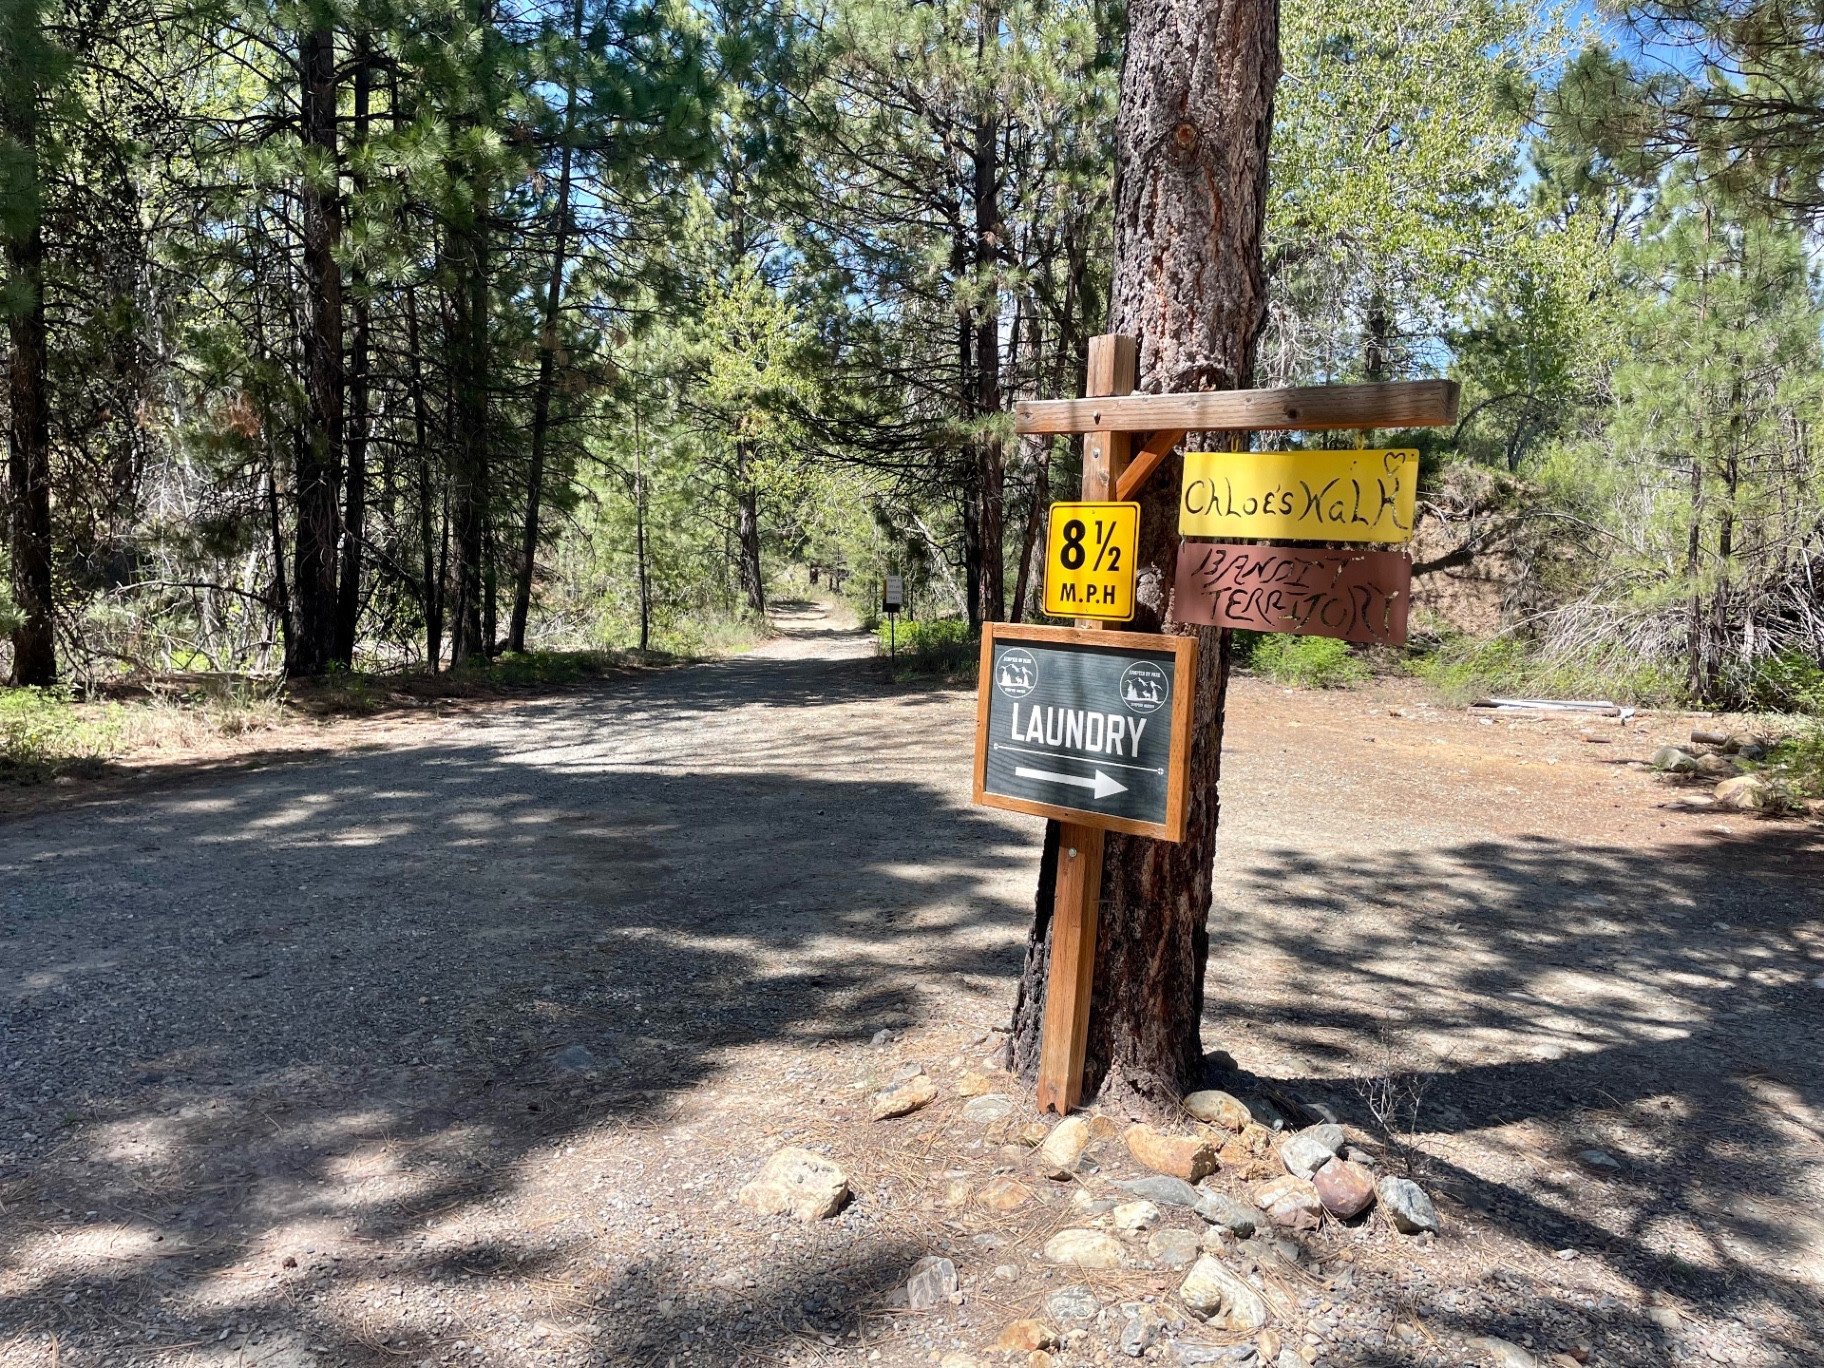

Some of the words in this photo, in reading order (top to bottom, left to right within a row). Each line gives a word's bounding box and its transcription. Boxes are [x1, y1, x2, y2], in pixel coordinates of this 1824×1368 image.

[1191, 549, 1365, 588] BANDIT
[1060, 583, 1116, 604] M.P.H
[1201, 582, 1399, 640] TERRITORY
[1012, 703, 1147, 757] LAUNDRY
